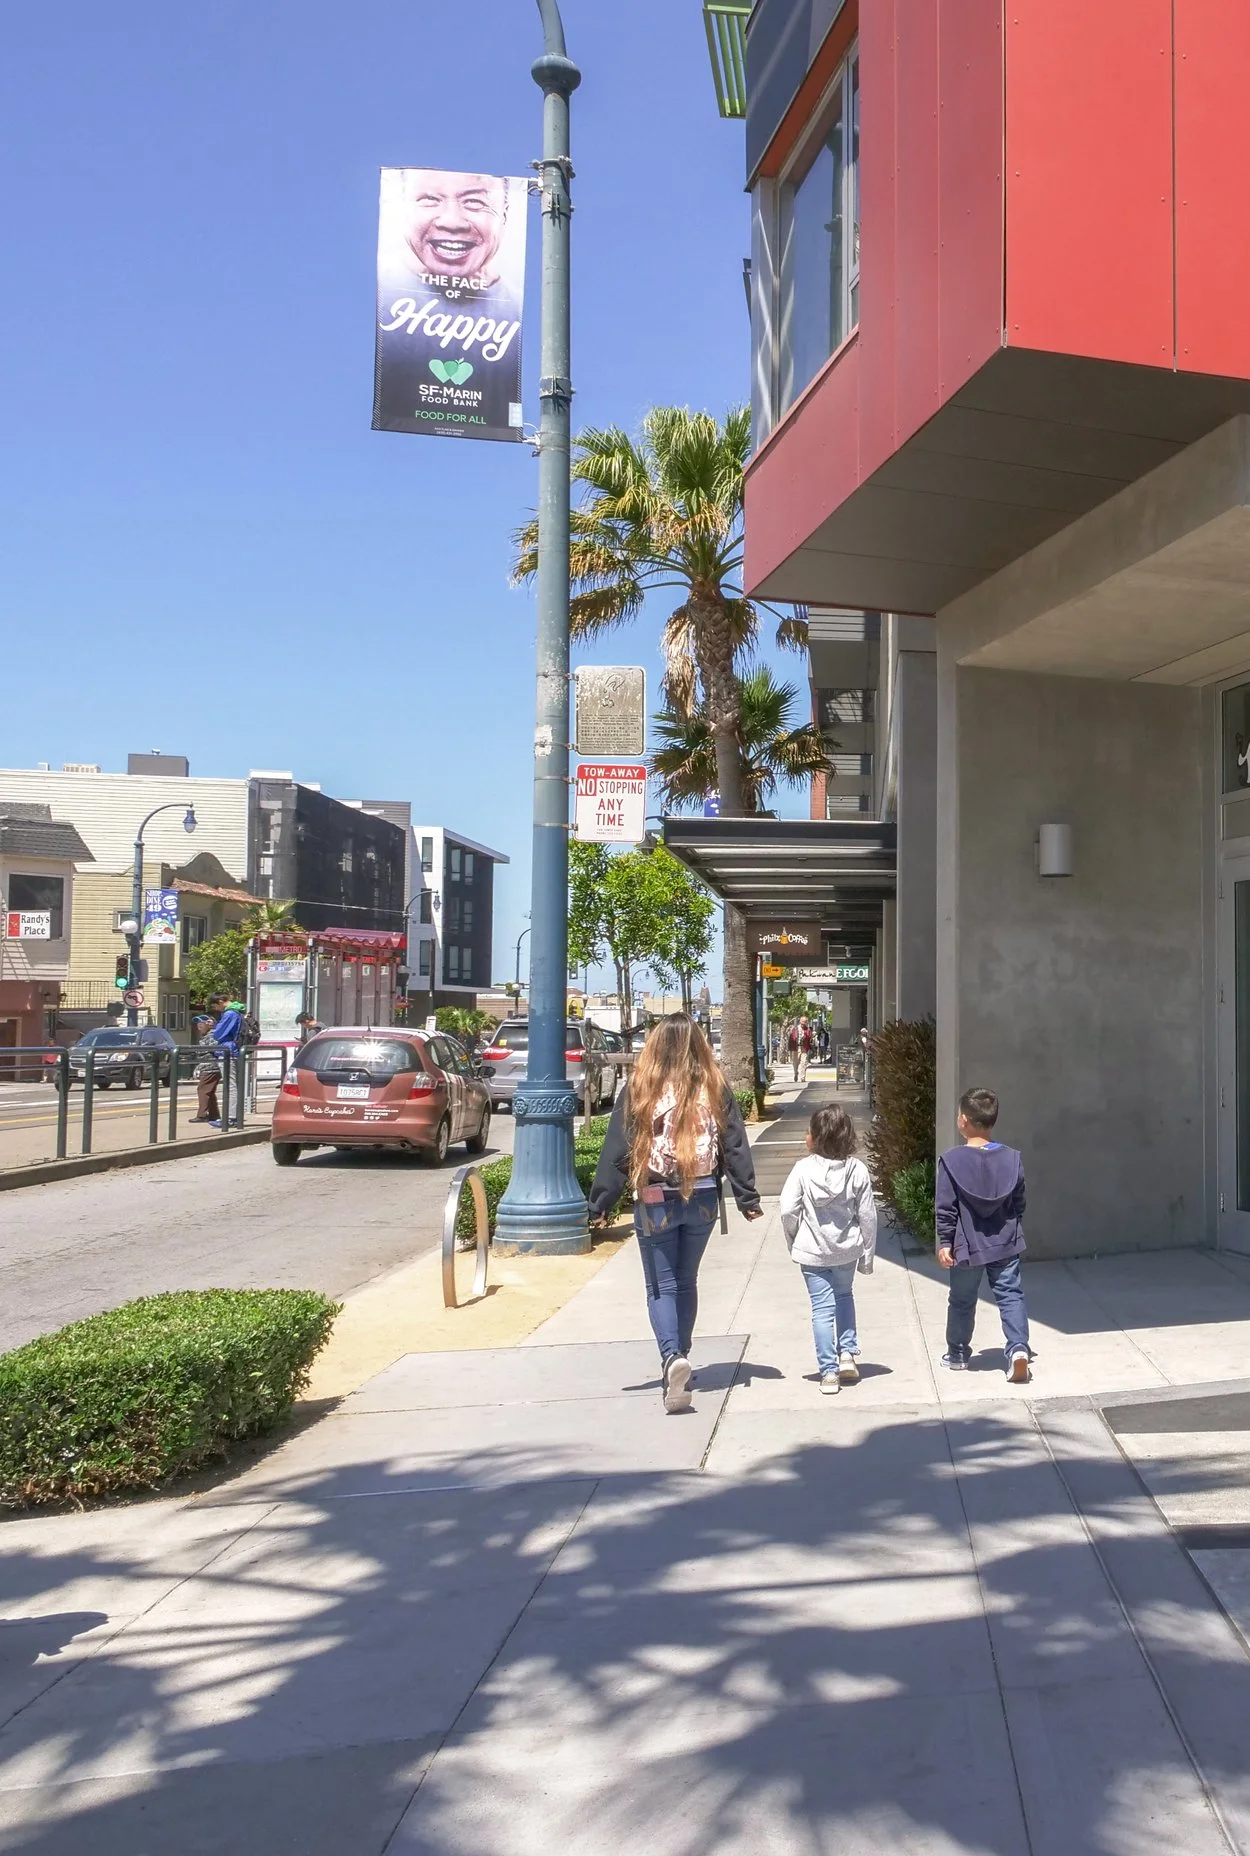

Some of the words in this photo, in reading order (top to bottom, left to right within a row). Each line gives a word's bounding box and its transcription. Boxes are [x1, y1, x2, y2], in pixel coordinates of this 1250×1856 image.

[419, 273, 448, 287] THE
[452, 276, 488, 291] FACE
[445, 290, 461, 299] OF
[380, 298, 521, 361] Happy
[421, 395, 449, 405] FOOD
[453, 398, 479, 408] BANK
[415, 410, 444, 421] FOOD
[446, 413, 467, 423] FOR
[468, 415, 487, 425] ALL
[583, 767, 640, 778] TOW-AWAY
[577, 778, 596, 796] NO
[599, 780, 643, 795] STOPPING
[597, 798, 624, 811] ANY
[595, 813, 625, 827] TIME
[21, 914, 50, 925] Randy's
[24, 926, 46, 935] Place
